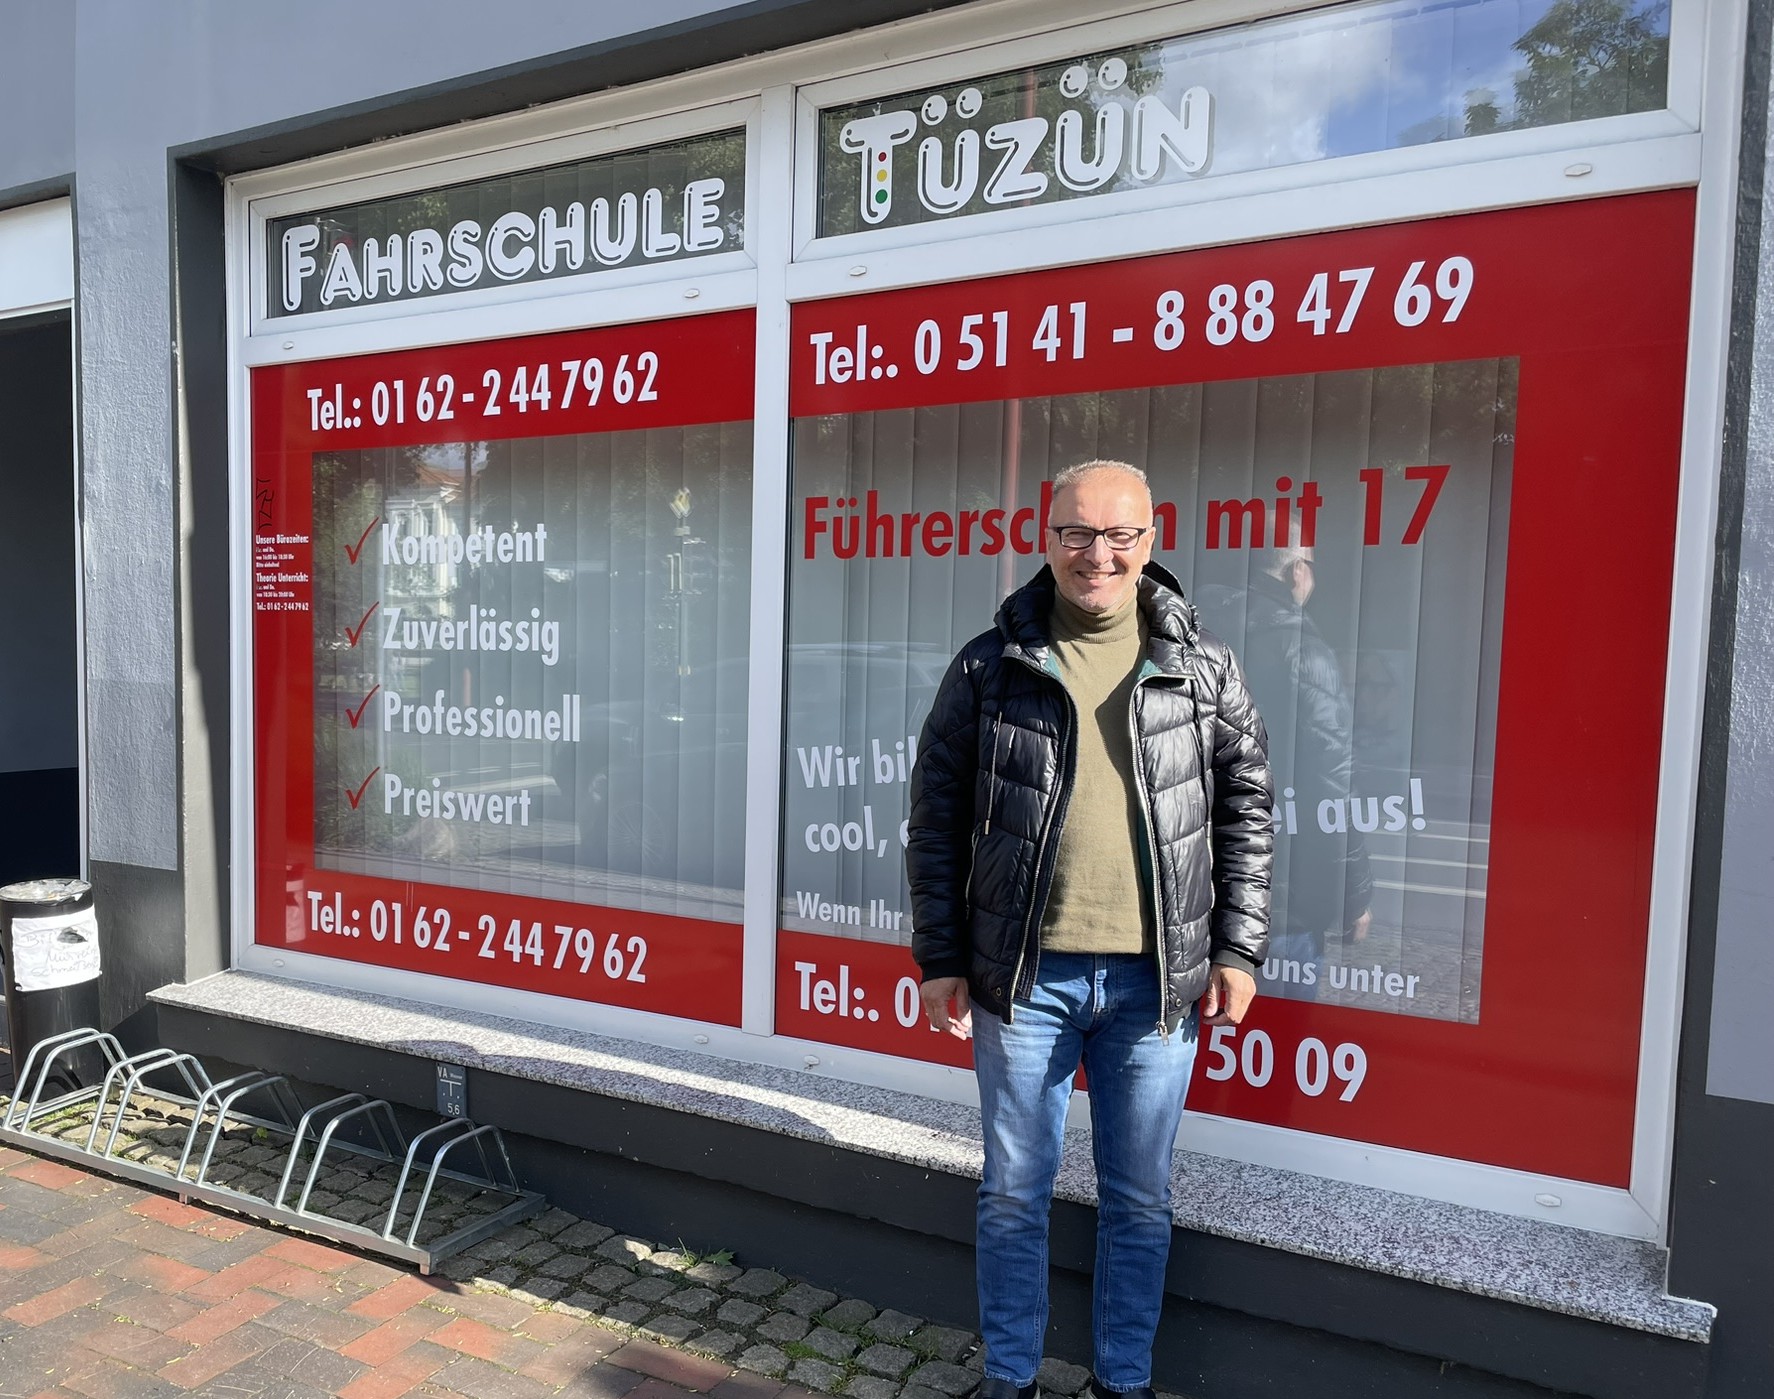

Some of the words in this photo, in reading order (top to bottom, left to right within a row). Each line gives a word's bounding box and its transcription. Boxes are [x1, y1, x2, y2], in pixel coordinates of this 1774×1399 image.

[839, 57, 1212, 224] TÜZÜN
[282, 177, 725, 312] FAHRSCHULE
[914, 319, 941, 375] 0
[956, 311, 1009, 371] 51
[1032, 301, 1087, 363] 41
[1153, 290, 1186, 351] 8
[1205, 279, 1275, 347] 88
[1296, 266, 1375, 336] 47
[1393, 255, 1474, 327] 69
[307, 383, 361, 431] Tel.:
[803, 480, 1177, 560] Führerscn
[1205, 476, 1323, 550] mit
[1359, 464, 1451, 546] 17
[256, 535, 275, 544] Unsere
[382, 523, 547, 567] Kompetent
[256, 572, 276, 582] Theorie
[277, 571, 309, 582] Unterricht:
[382, 604, 560, 666] Zuverlässig
[384, 689, 580, 742] Professionell
[797, 745, 860, 789] Wir
[871, 735, 918, 784] bil
[384, 773, 531, 826] Preiswert
[1317, 778, 1427, 834] aus!
[804, 805, 888, 858] cool,
[307, 890, 360, 939] Tel.:
[796, 890, 860, 926] Wenn
[869, 899, 903, 931] Ihr
[1262, 957, 1317, 985] uns
[1329, 964, 1420, 999] unter
[437, 1066, 448, 1079] VA
[1205, 1025, 1274, 1088] 50
[1295, 1037, 1368, 1103] 09
[447, 1102, 460, 1116] 5,6
